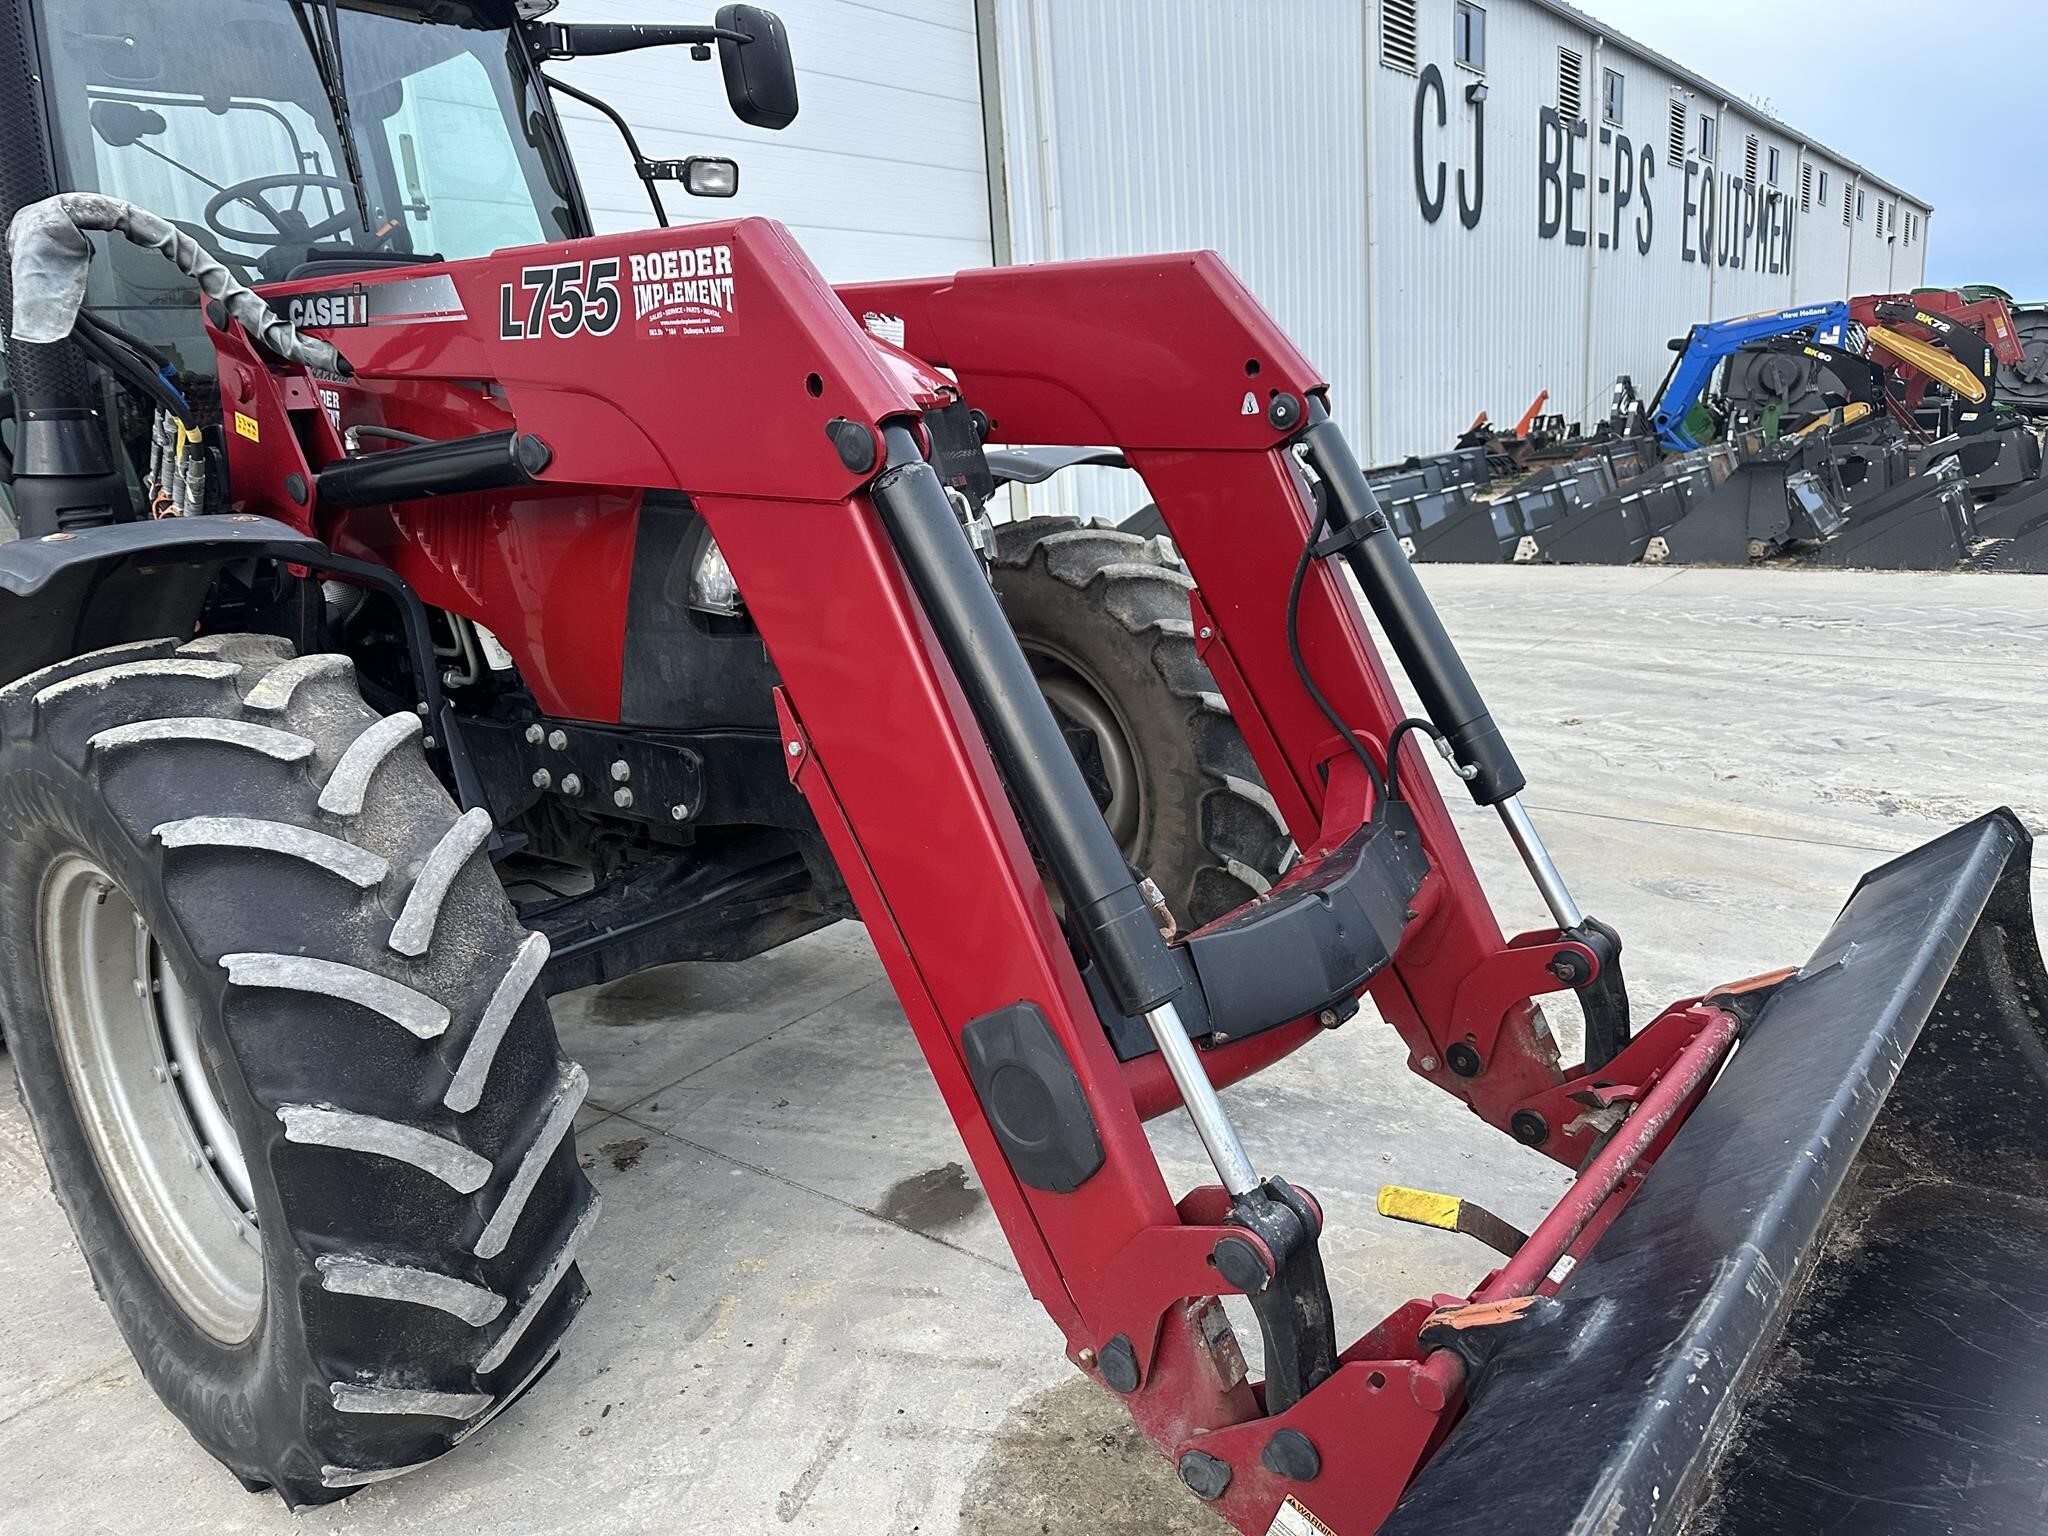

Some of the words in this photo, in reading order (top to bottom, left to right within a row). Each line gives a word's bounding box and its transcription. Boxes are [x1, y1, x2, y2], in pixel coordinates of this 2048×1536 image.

[1538, 104, 1656, 257] BEEPS
[1681, 158, 1798, 277] EQUIPMEN
[628, 245, 733, 283] ROEDER
[288, 296, 346, 328] CASE
[499, 256, 622, 342] L755
[632, 276, 735, 321] IMPLEMENT
[665, 306, 684, 316] SERVICE
[685, 306, 701, 314] PARTS
[1782, 311, 1799, 320] New
[1799, 307, 1827, 318] Holland
[1914, 311, 1952, 334] BK72
[1296, 1503, 1339, 1536] WARNIN
